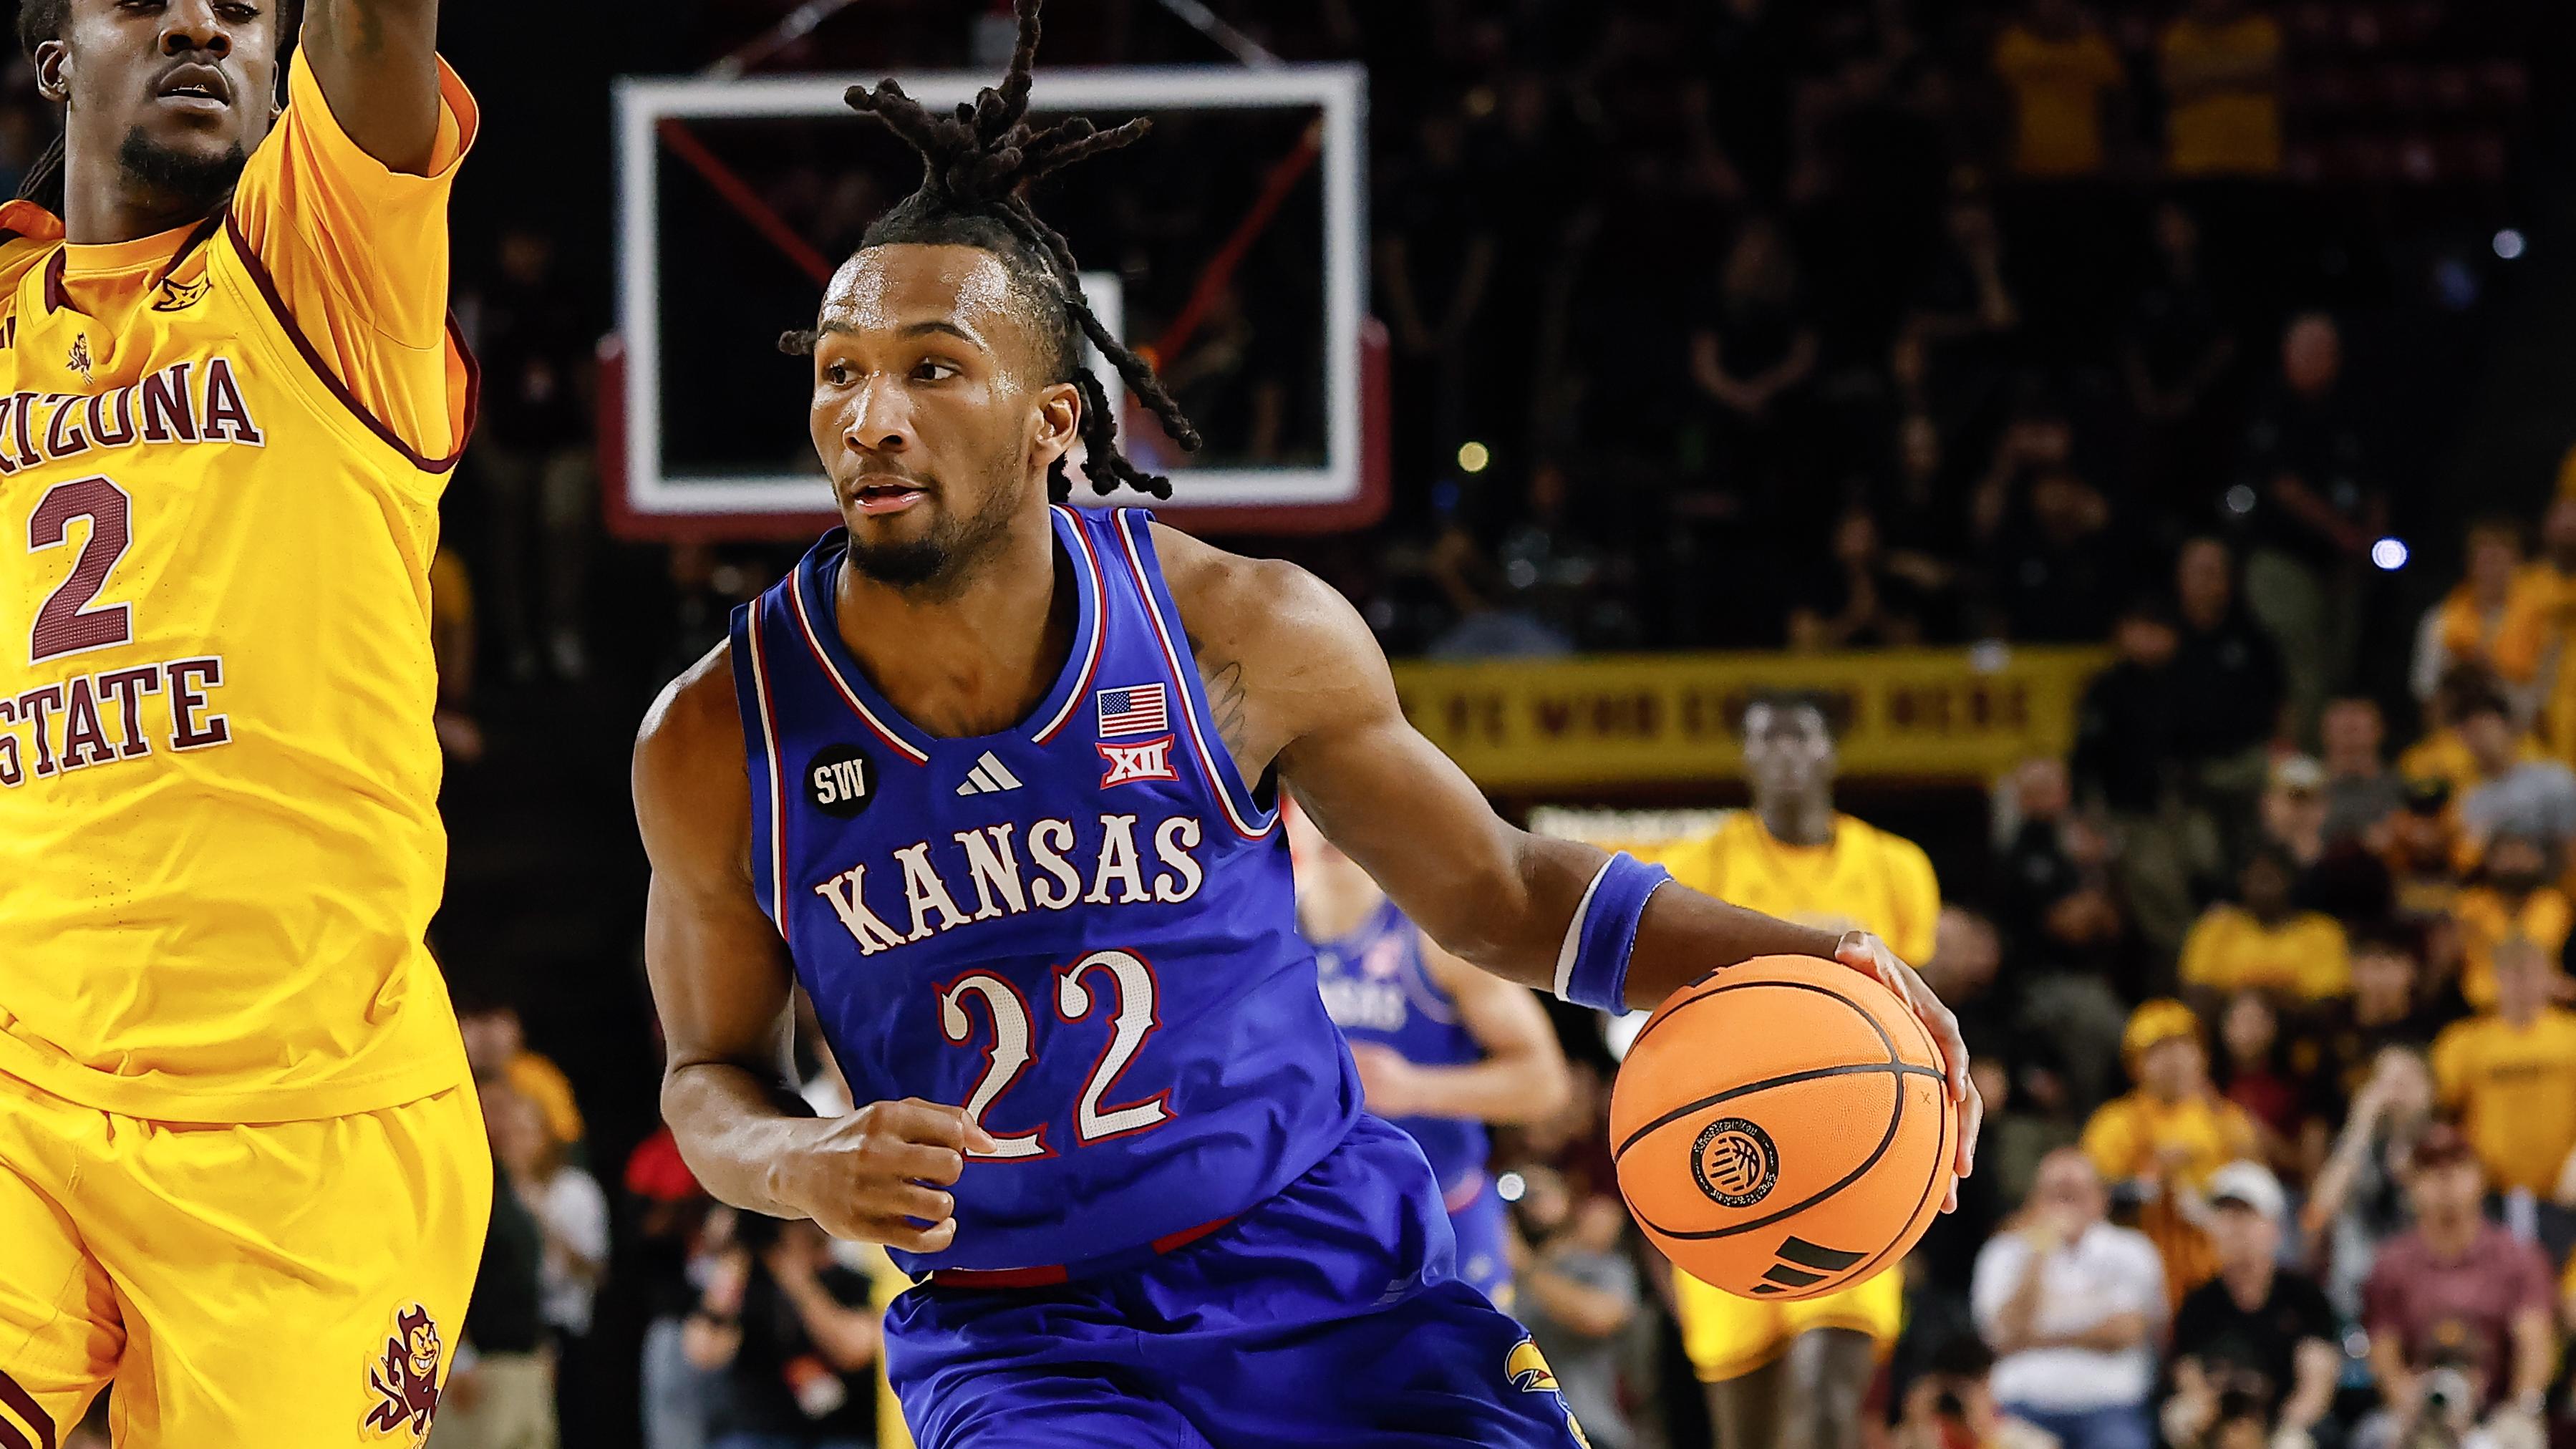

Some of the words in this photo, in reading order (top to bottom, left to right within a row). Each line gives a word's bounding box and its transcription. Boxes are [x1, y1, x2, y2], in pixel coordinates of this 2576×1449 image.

[26, 473, 133, 666] 2
[813, 758, 866, 805] SW
[1100, 739, 1173, 785] XII
[813, 813, 1204, 957] KANSAS
[932, 947, 1178, 1163] 22
